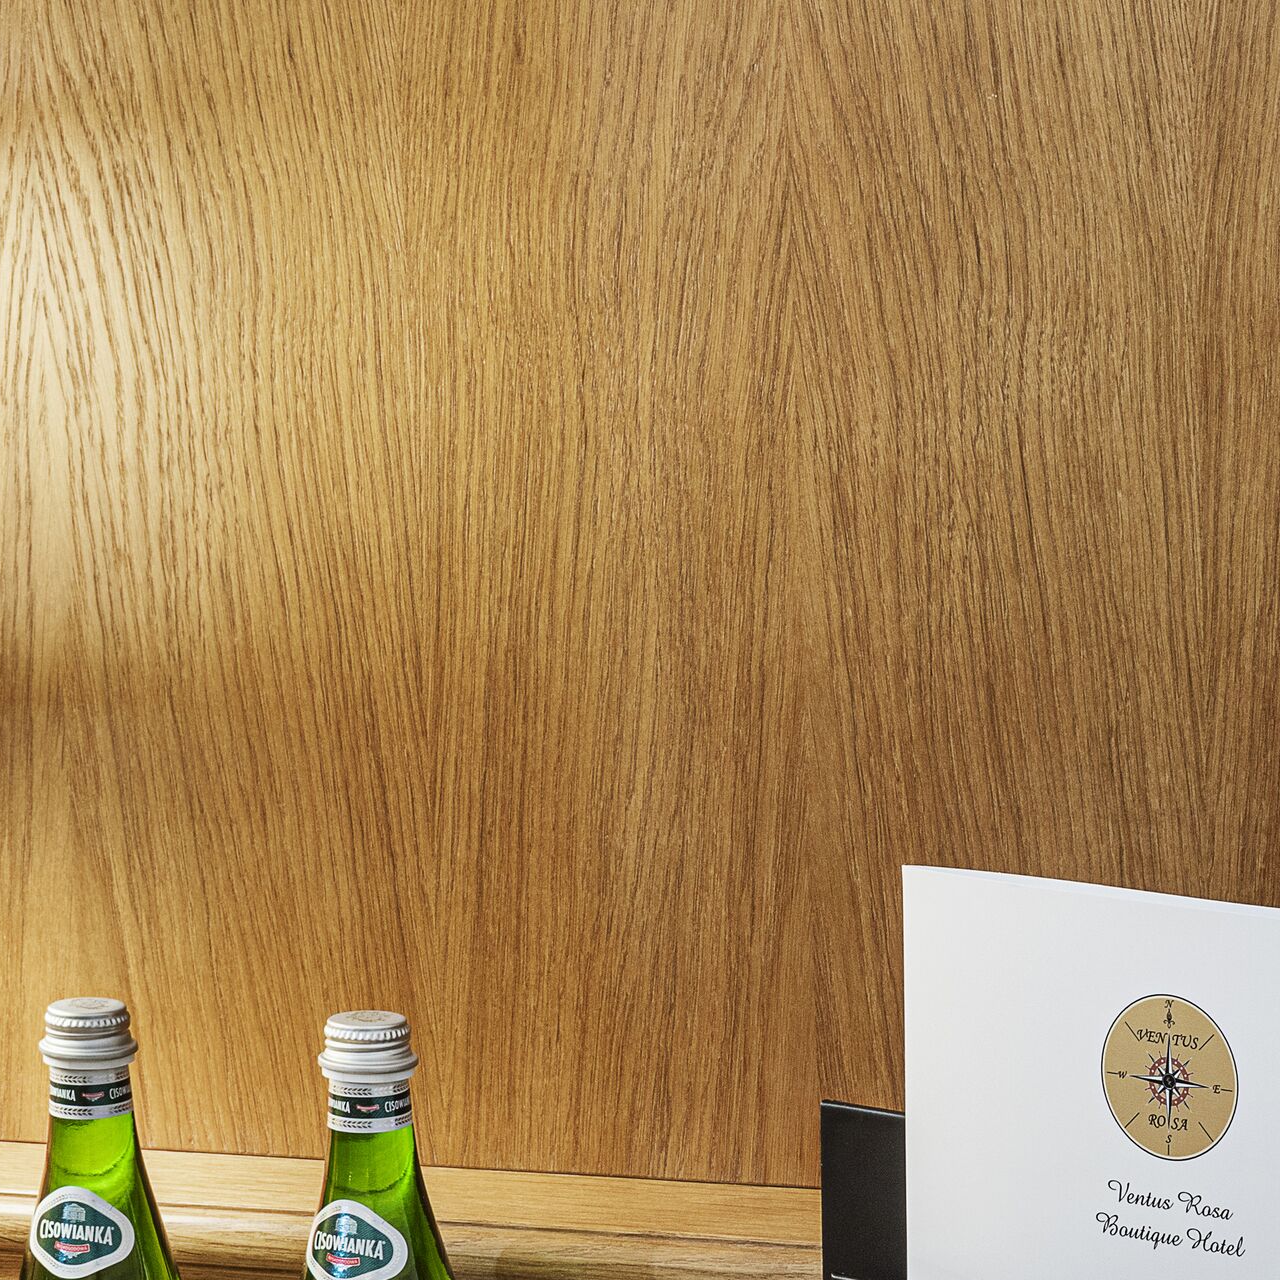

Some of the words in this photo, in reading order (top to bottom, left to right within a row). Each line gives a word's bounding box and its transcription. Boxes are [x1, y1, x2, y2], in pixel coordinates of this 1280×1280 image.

[1164, 1000, 1174, 1008] N
[1212, 1085, 1221, 1094] E
[1165, 1135, 1173, 1144] S
[1107, 1179, 1174, 1210] Ventus
[1177, 1191, 1234, 1221] Rosa
[39, 1218, 114, 1246] CISOWIANKA
[314, 1230, 384, 1260] CISOWIANKA
[1095, 1212, 1183, 1250] Boutique
[1186, 1227, 1246, 1257] Hotel
